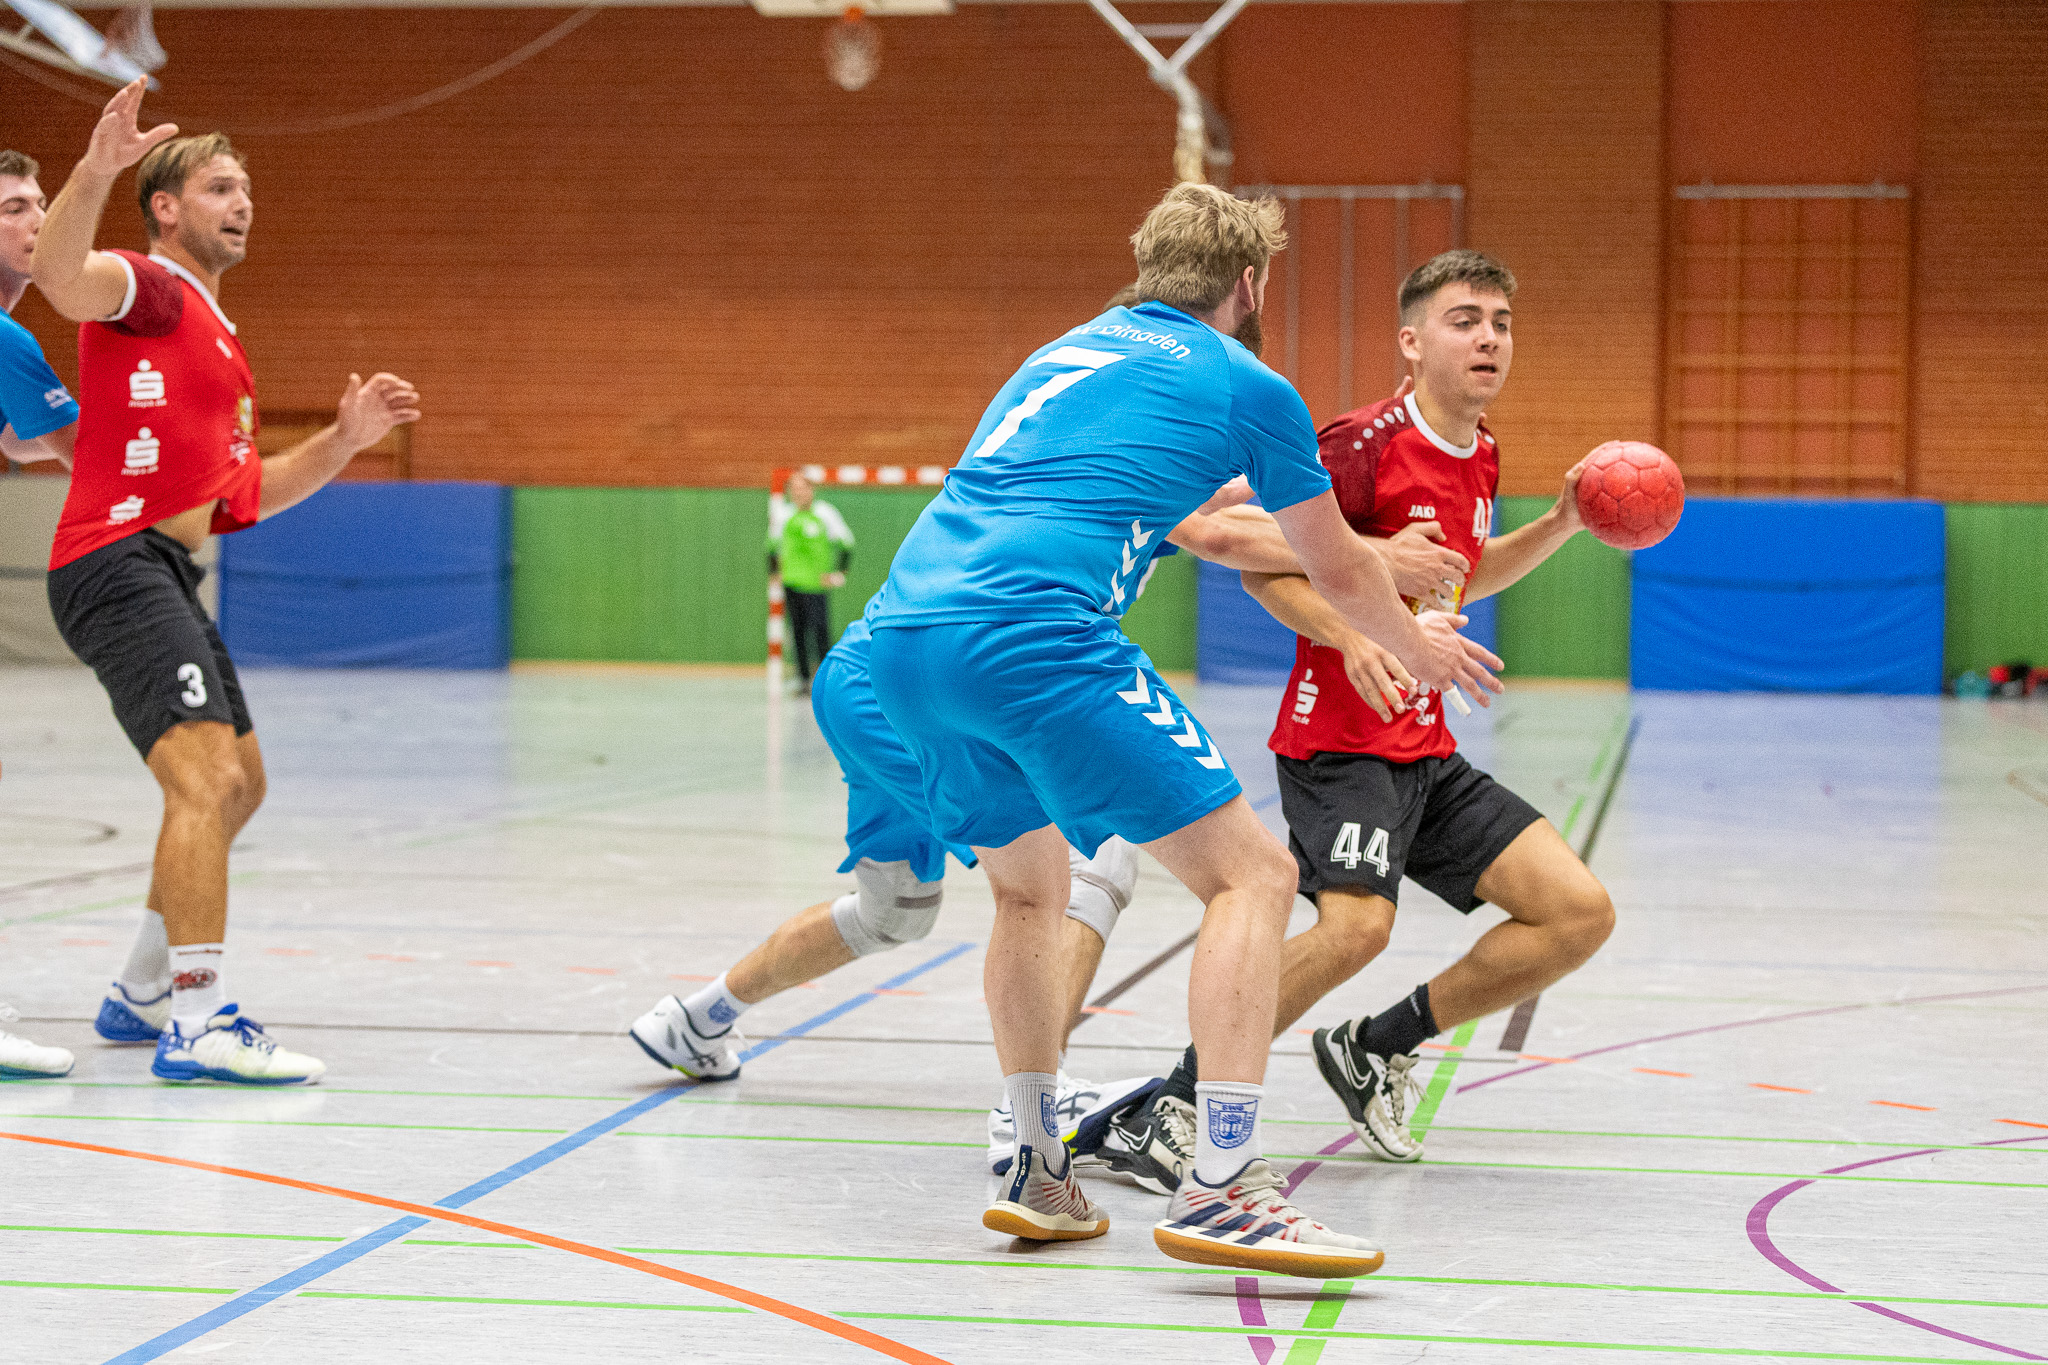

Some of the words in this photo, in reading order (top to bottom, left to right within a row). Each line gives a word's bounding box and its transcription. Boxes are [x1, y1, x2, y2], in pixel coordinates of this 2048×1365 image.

[1098, 325, 1191, 360] Dingden
[973, 345, 1127, 458] 7
[177, 663, 207, 708] 3
[1330, 822, 1390, 877] 44
